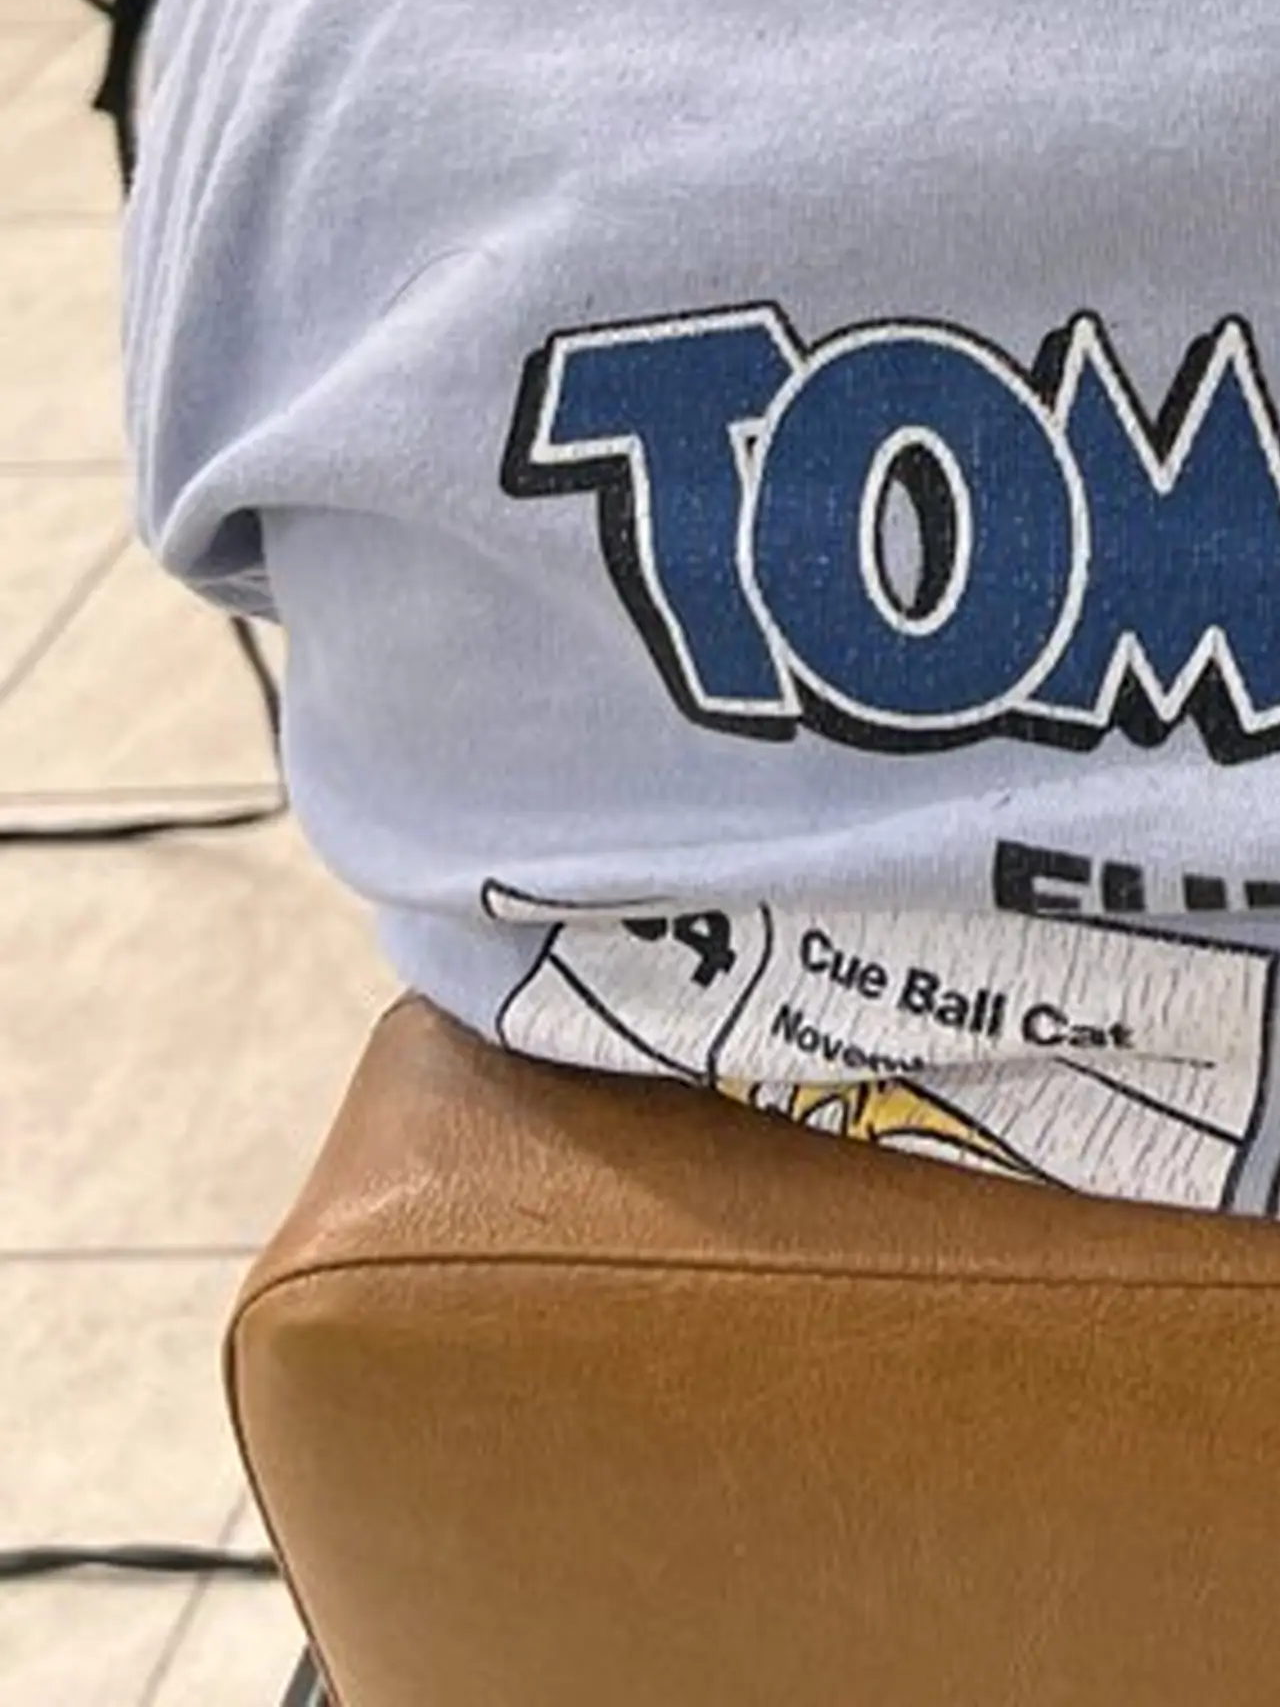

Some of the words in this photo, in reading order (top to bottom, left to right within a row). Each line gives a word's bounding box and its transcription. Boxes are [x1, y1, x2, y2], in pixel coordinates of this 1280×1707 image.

[800, 928, 889, 999] Cue
[900, 966, 1007, 1038] Ball
[1021, 1002, 1135, 1050] Cat
